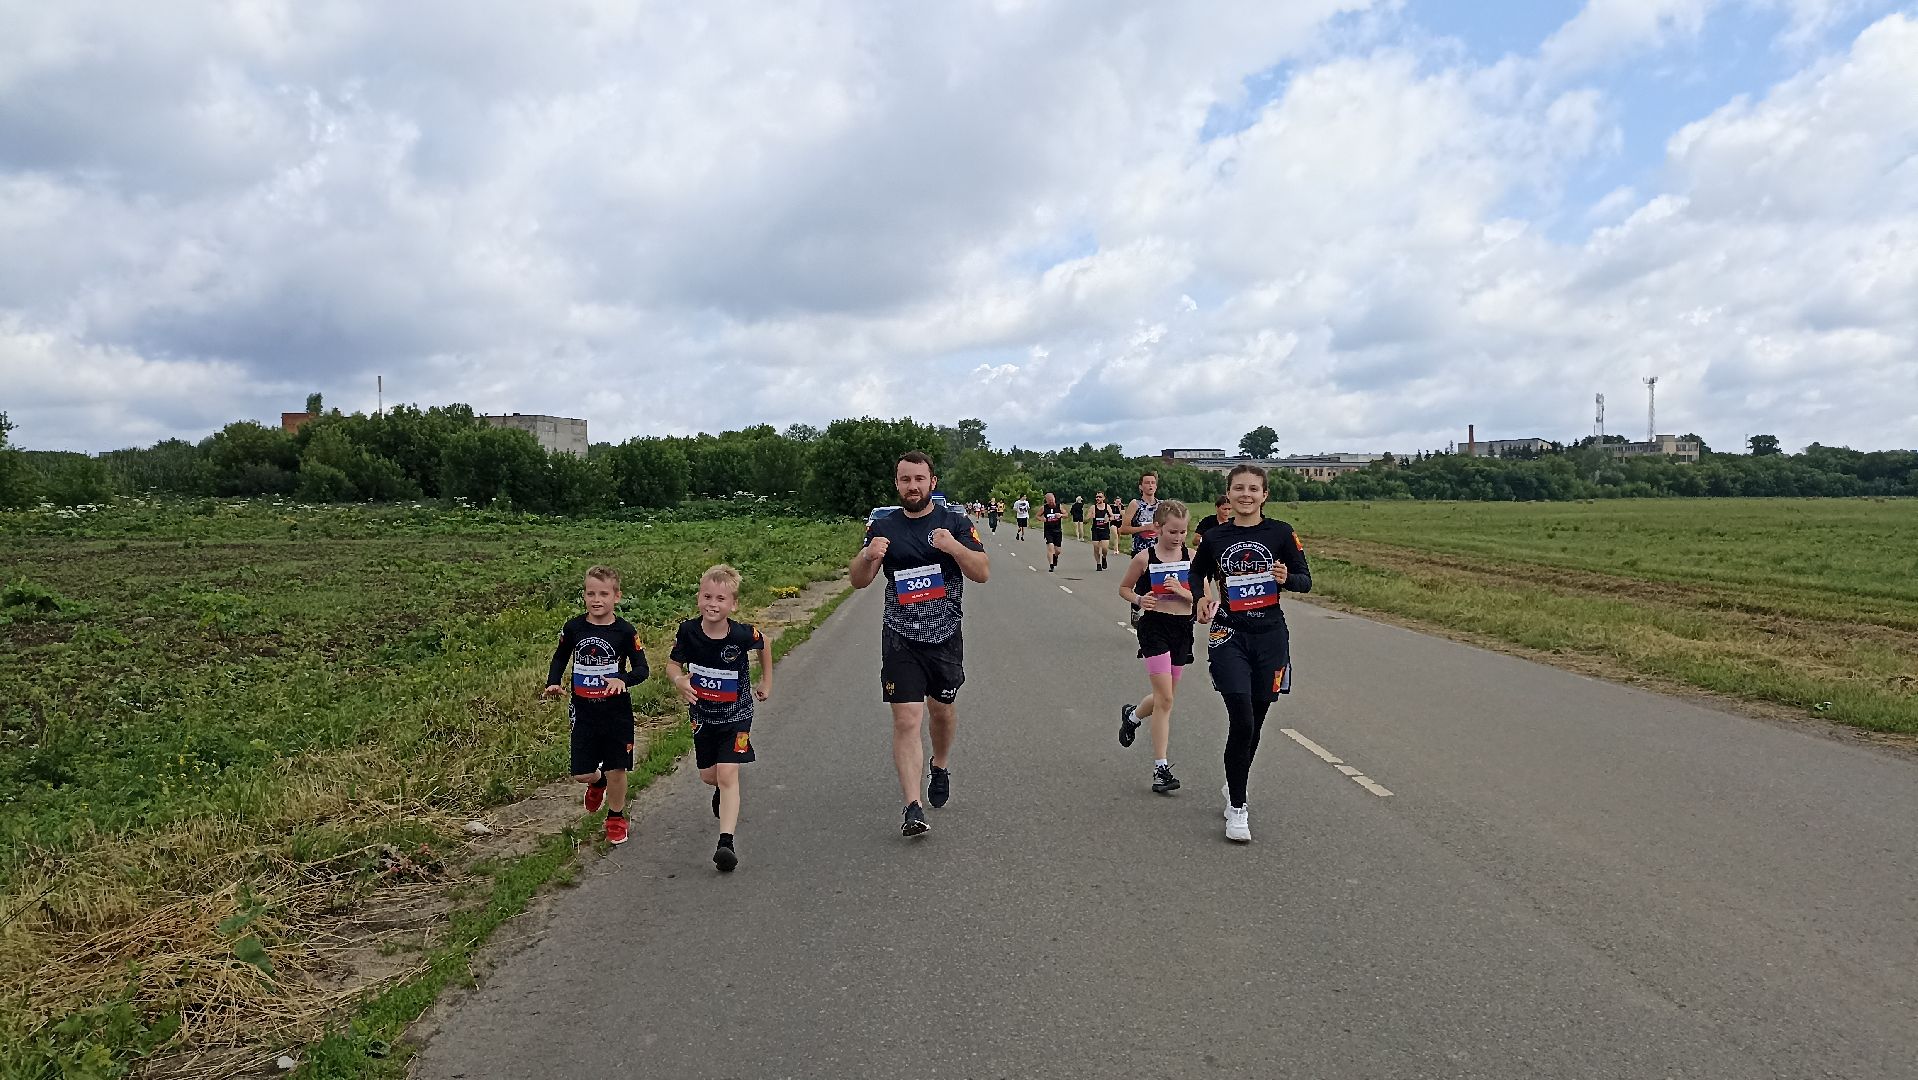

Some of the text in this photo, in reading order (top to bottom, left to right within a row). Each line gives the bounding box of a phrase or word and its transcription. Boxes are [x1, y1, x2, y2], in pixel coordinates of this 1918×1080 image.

[906, 577, 932, 591] 360
[1240, 584, 1266, 598] 342
[699, 677, 722, 690] 361
